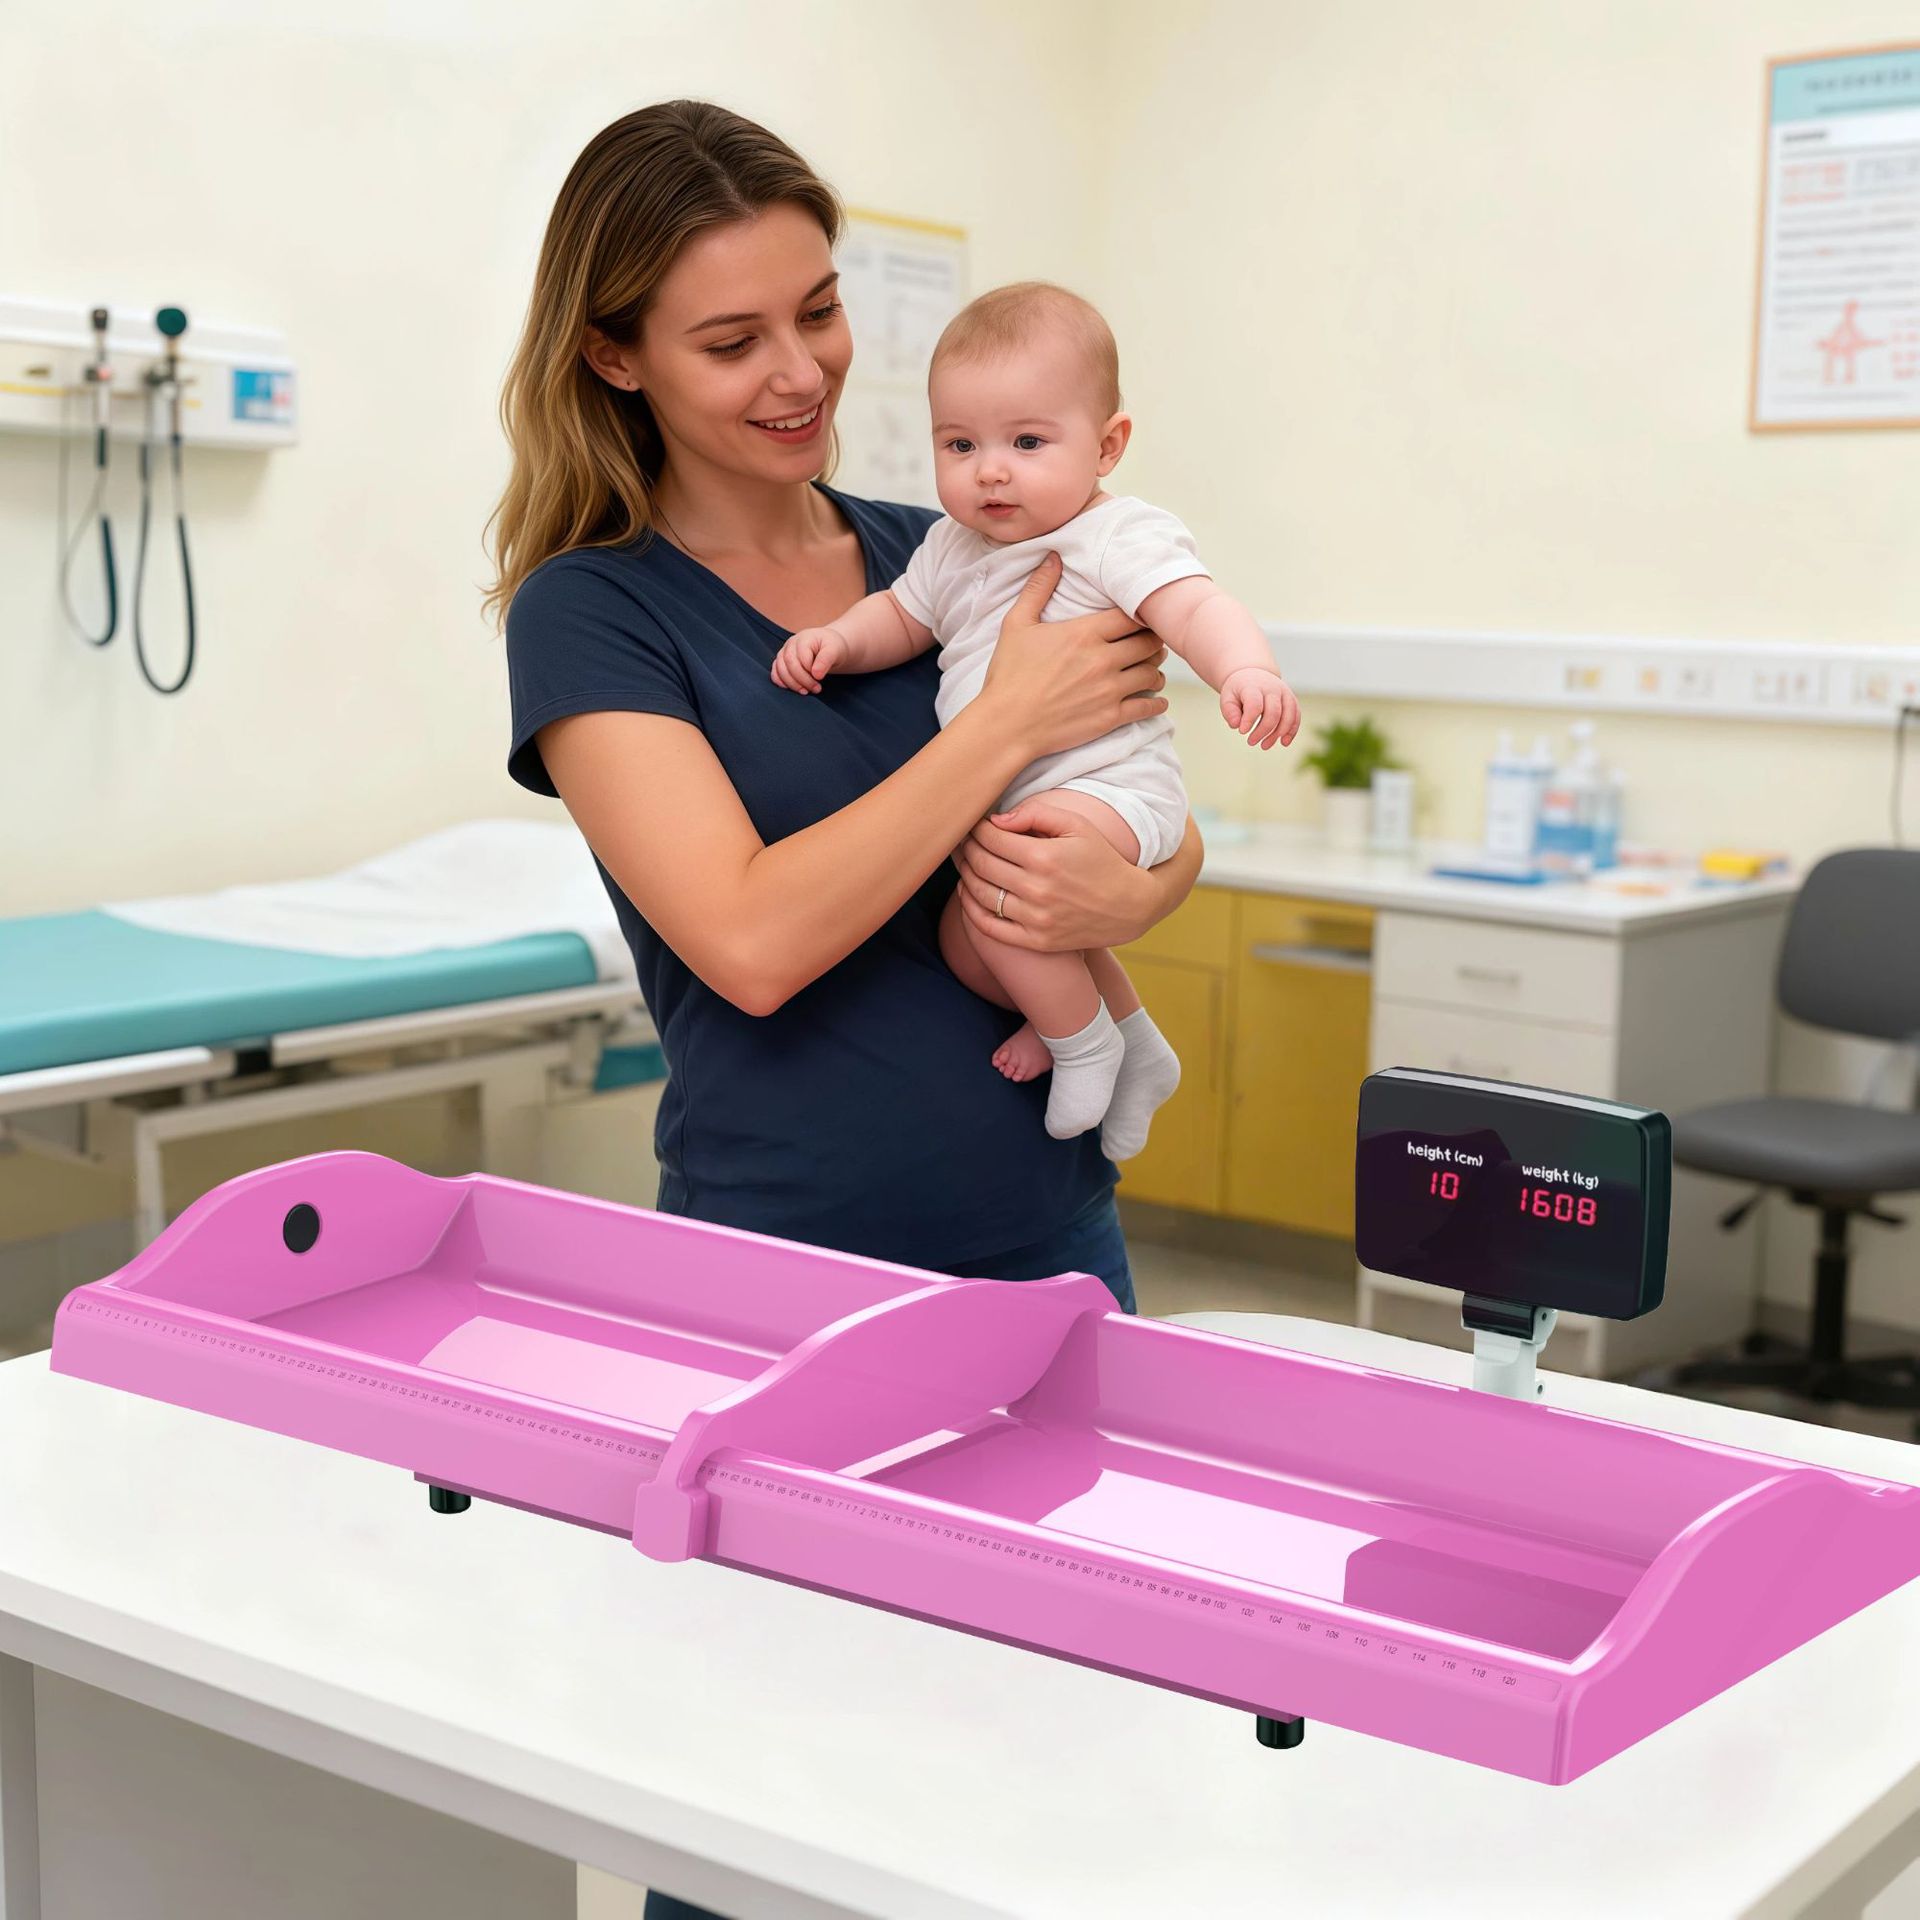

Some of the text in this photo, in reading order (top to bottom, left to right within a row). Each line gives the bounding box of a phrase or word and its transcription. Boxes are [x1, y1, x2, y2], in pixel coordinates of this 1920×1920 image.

[1407, 1141, 1484, 1167] height (cm)
[1430, 1171, 1460, 1200] 10
[1521, 1165, 1599, 1190] weight (kg)
[1519, 1187, 1598, 1226] 1608
[707, 1468, 716, 1476] 60
[719, 1471, 728, 1479] 61
[730, 1473, 739, 1482] 62
[741, 1477, 750, 1485] 63
[753, 1480, 761, 1488] 64
[765, 1483, 774, 1491] 65
[777, 1486, 786, 1494] 66
[788, 1489, 798, 1497] 67
[800, 1492, 810, 1500] 68
[812, 1495, 822, 1504] 69
[825, 1498, 833, 1507] 70
[869, 1510, 878, 1518] 73
[880, 1513, 890, 1521] 74
[893, 1516, 902, 1525] 75
[904, 1519, 915, 1528] 76
[918, 1523, 927, 1531] 77
[930, 1526, 939, 1534] 78
[943, 1529, 952, 1538] 79
[954, 1532, 964, 1541] 80
[966, 1535, 976, 1544] 81
[978, 1539, 988, 1547] 82
[991, 1542, 1001, 1551] 83
[1003, 1545, 1013, 1554] 84
[1016, 1549, 1026, 1557] 85
[1029, 1552, 1040, 1561] 86
[1042, 1555, 1054, 1564] 87
[1055, 1559, 1065, 1567] 88
[1068, 1562, 1078, 1571] 89
[1081, 1566, 1092, 1575] 90
[1094, 1569, 1104, 1578] 91
[1106, 1572, 1116, 1581] 92
[1119, 1575, 1130, 1585] 93
[1133, 1579, 1143, 1588] 94
[1146, 1582, 1157, 1592] 95
[1160, 1586, 1170, 1595] 96
[1172, 1589, 1184, 1599] 97
[1186, 1593, 1198, 1602] 98
[1200, 1597, 1211, 1606] 99
[1213, 1600, 1226, 1610] 100
[1240, 1607, 1254, 1617] 102
[1269, 1615, 1282, 1624] 104
[1296, 1622, 1311, 1632] 106
[1325, 1629, 1339, 1639] 108
[1354, 1637, 1367, 1647] 110
[1383, 1644, 1397, 1655] 112
[1412, 1652, 1426, 1662] 114
[1441, 1660, 1456, 1670] 116
[1471, 1668, 1486, 1678] 118
[1502, 1676, 1516, 1686] 120
